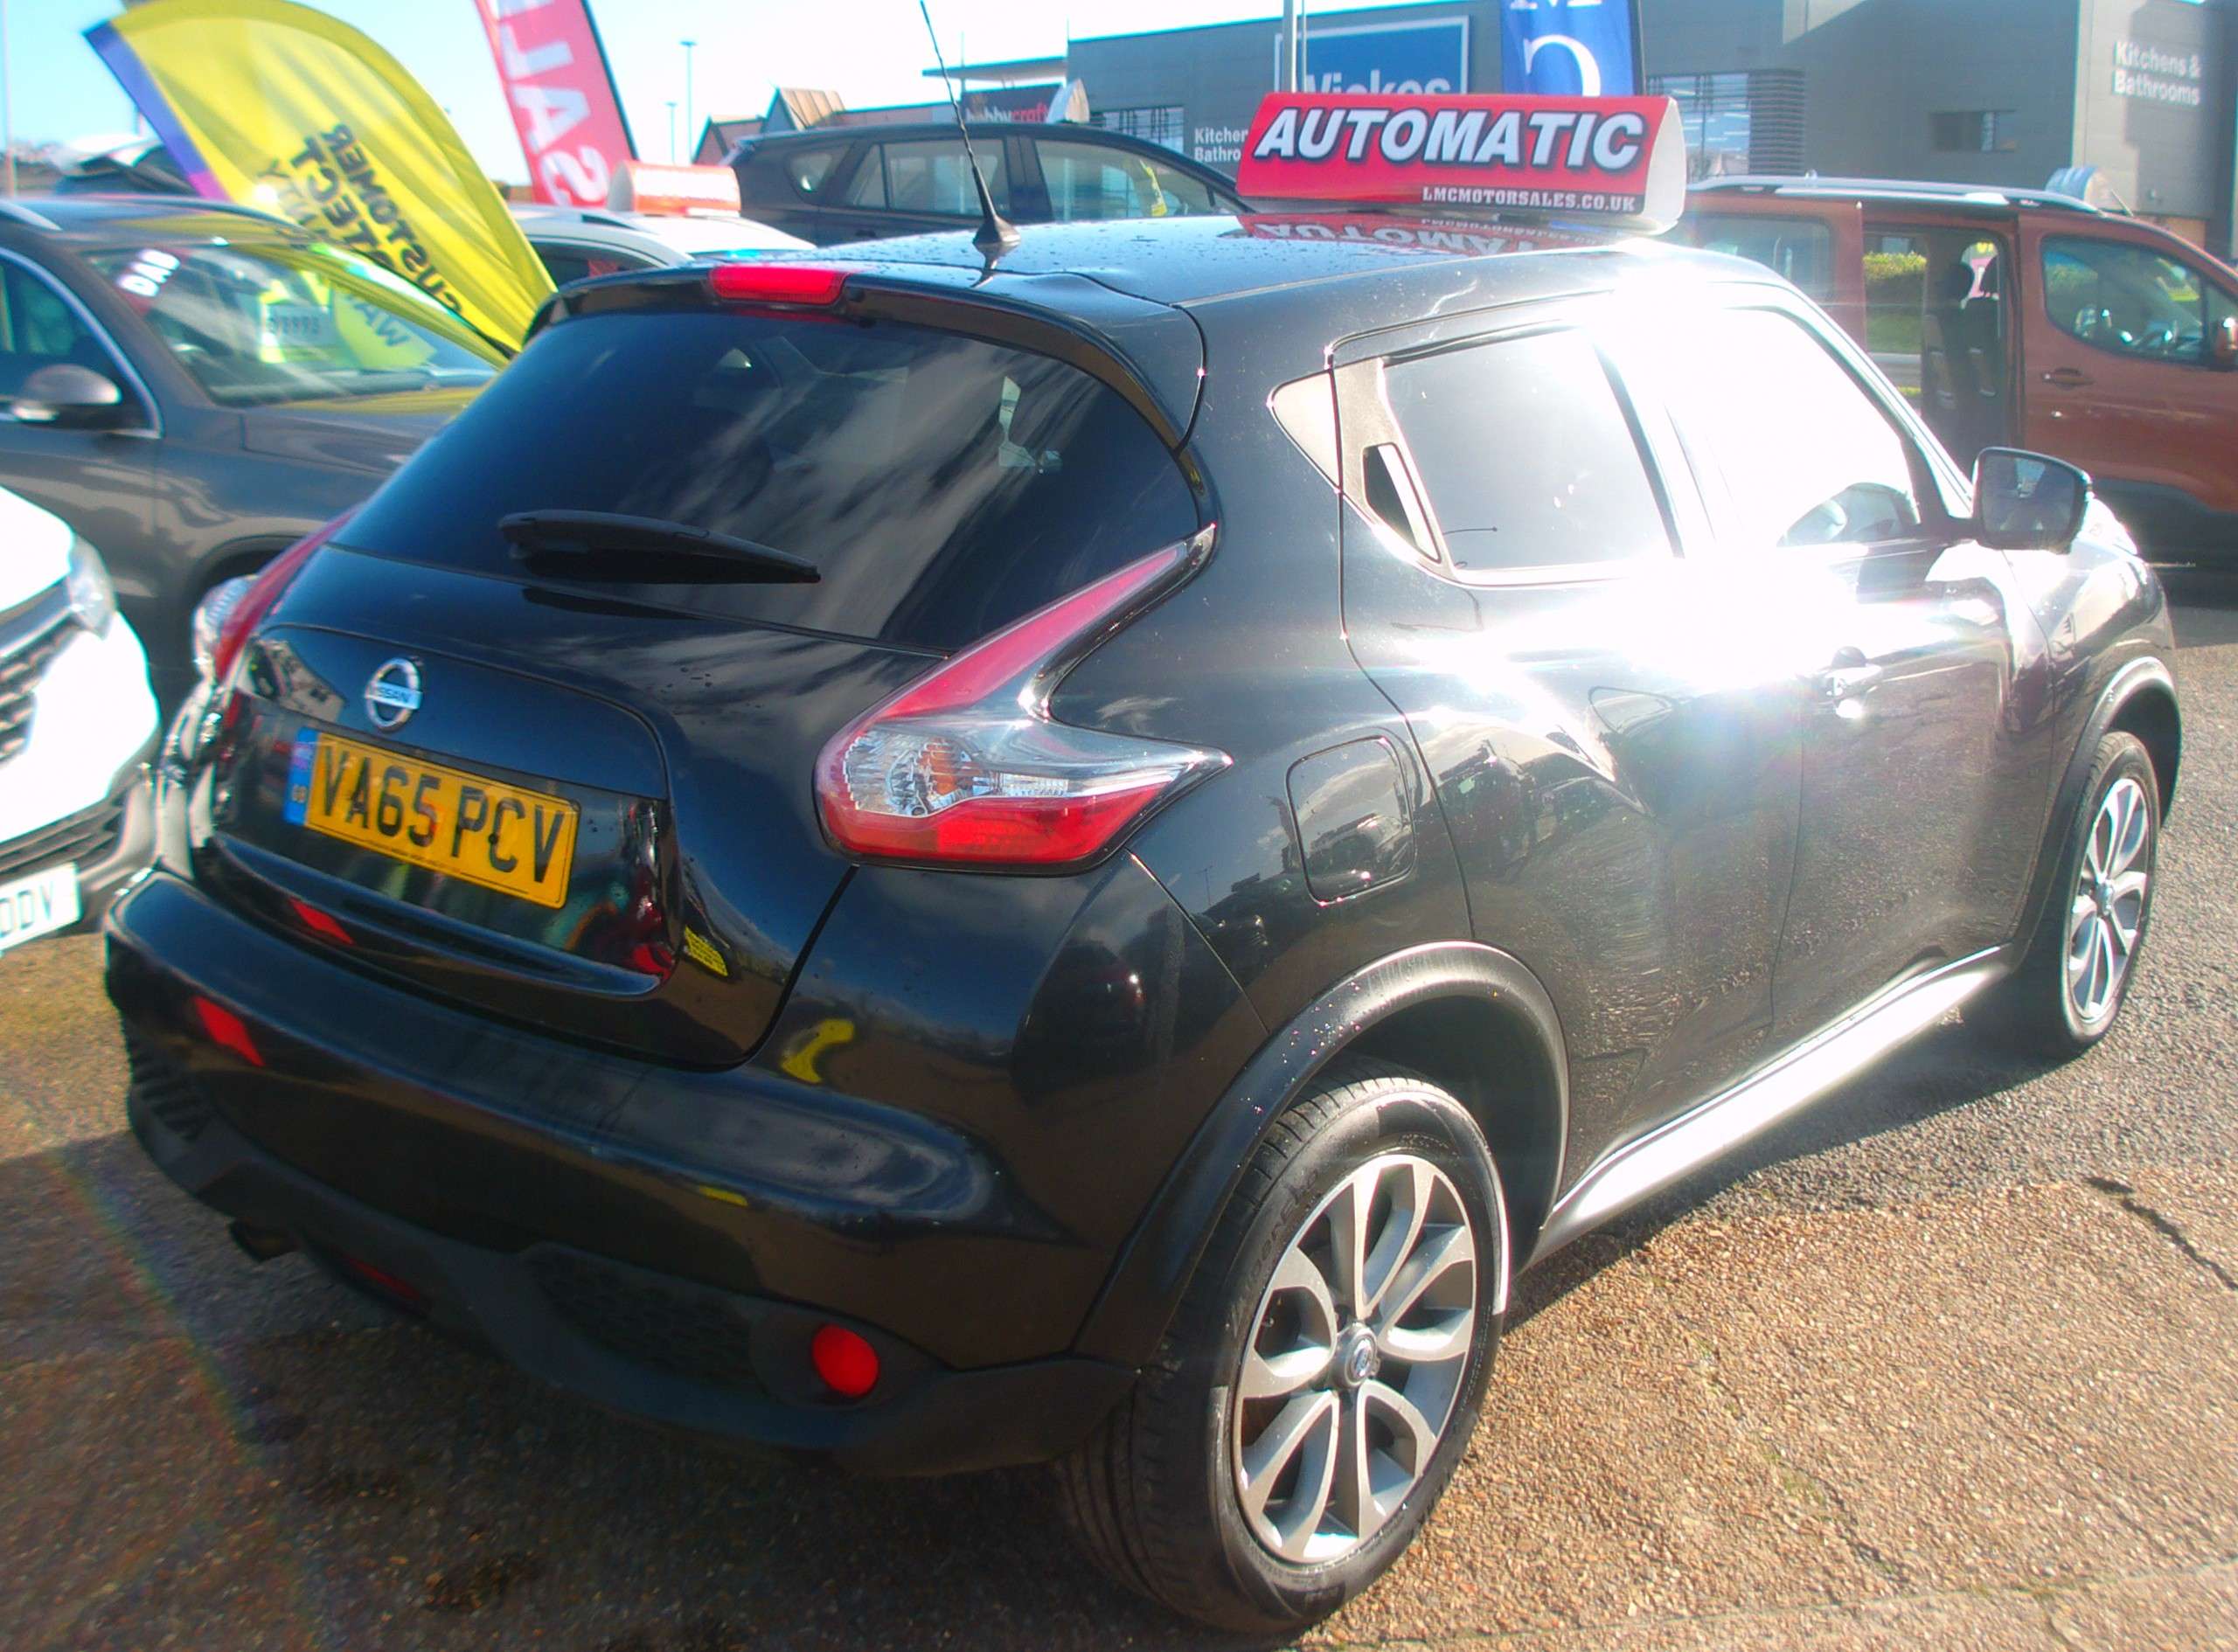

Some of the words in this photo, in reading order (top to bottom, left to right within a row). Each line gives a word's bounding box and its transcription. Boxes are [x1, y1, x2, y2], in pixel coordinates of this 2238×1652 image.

[2113, 41, 2186, 75] Kitchens
[2188, 54, 2200, 79] &
[2113, 69, 2200, 105] Bathrooms
[1253, 108, 1646, 170] AUTOMATIC
[1421, 185, 1636, 212] LMCMOTORSALES.CO.UK
[321, 744, 442, 849] VA65
[449, 784, 565, 885] PCV
